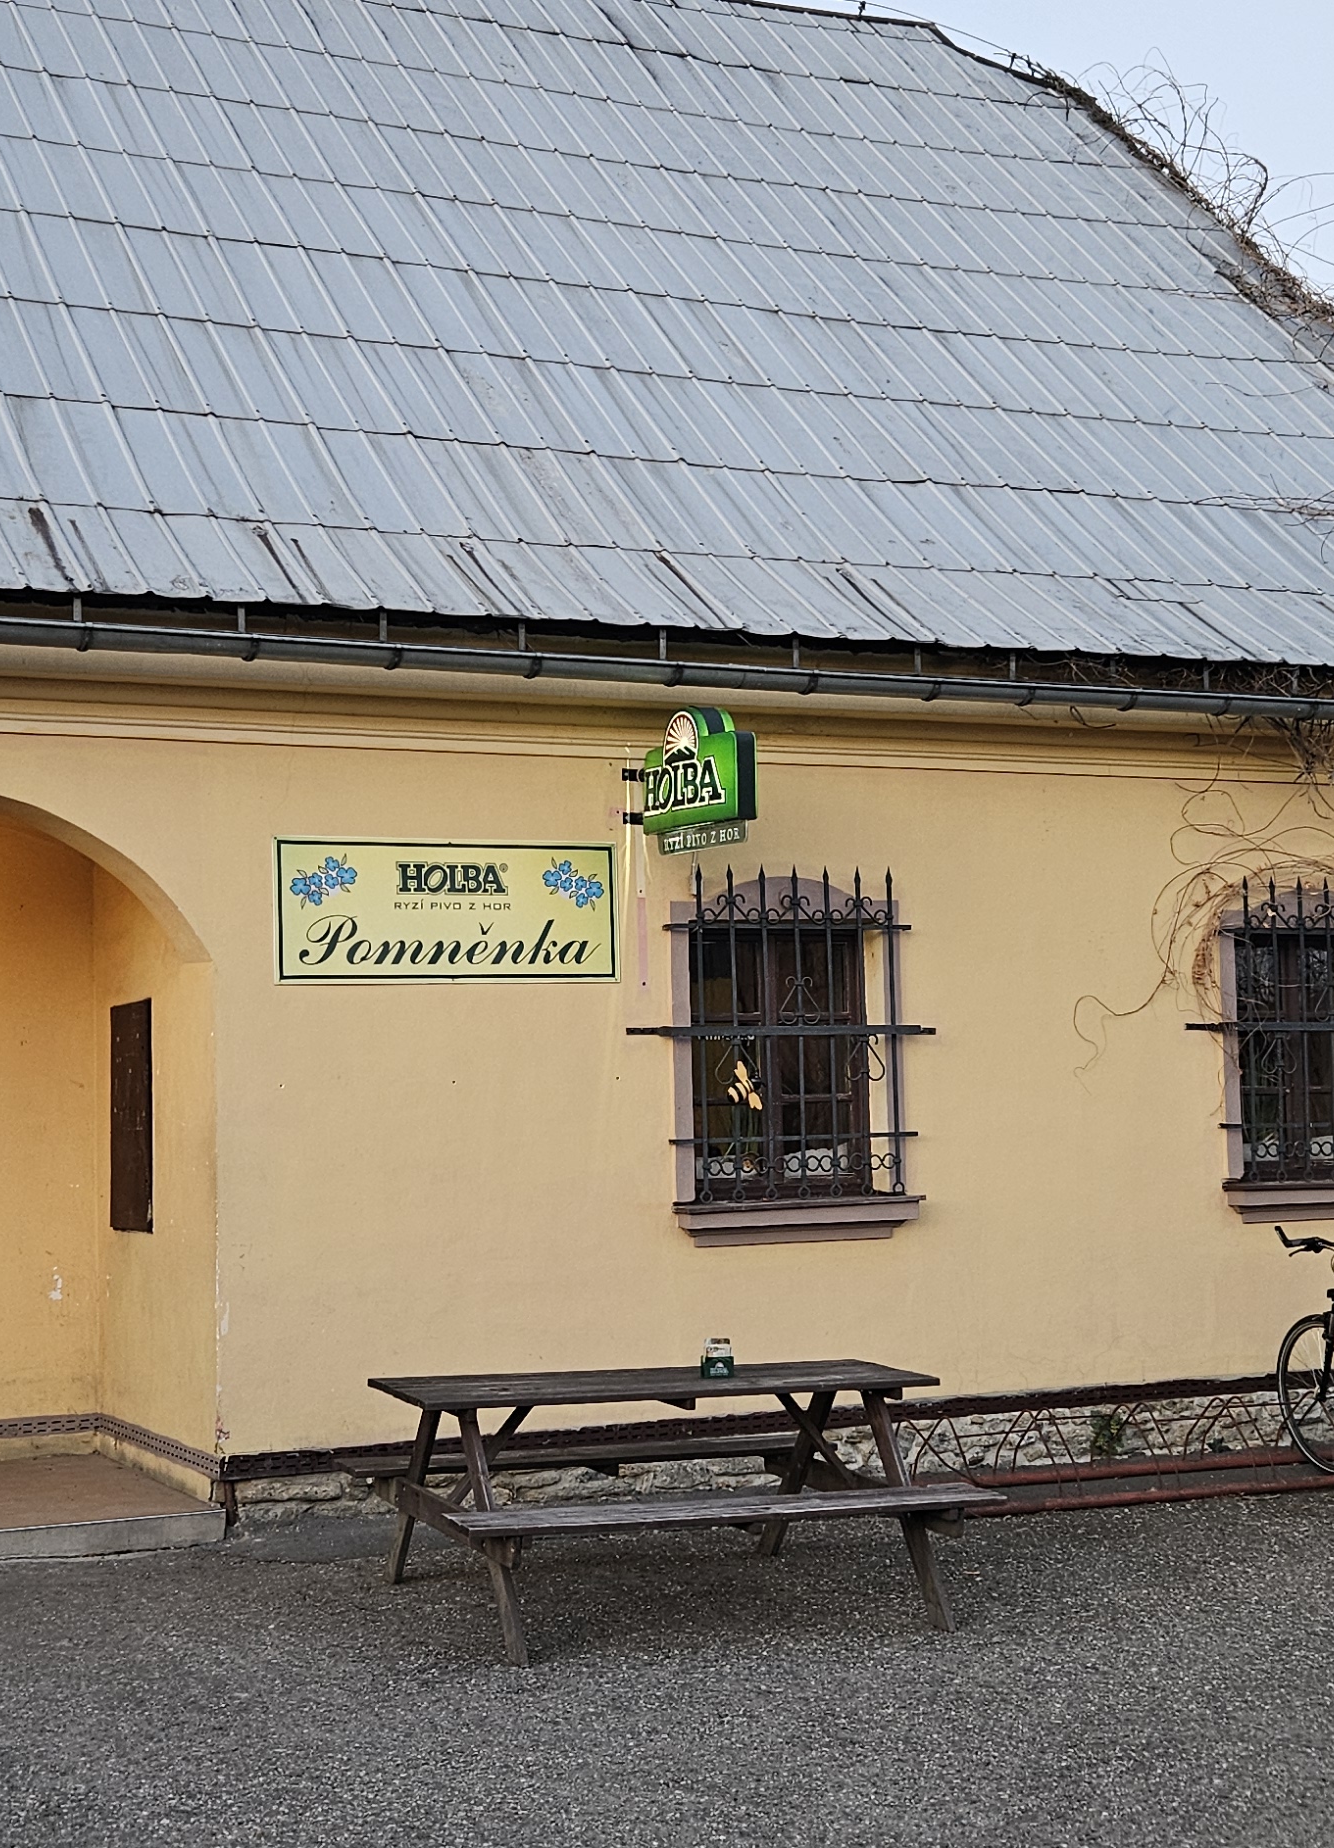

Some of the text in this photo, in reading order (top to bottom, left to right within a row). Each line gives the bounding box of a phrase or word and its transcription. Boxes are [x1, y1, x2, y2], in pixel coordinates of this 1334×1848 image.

[644, 755, 726, 817] HOLBA
[710, 831, 716, 844] Z
[719, 827, 740, 842] HOR
[394, 899, 511, 911] RYZÍ PIVO Z HOR
[298, 914, 602, 966] Pomněnka
